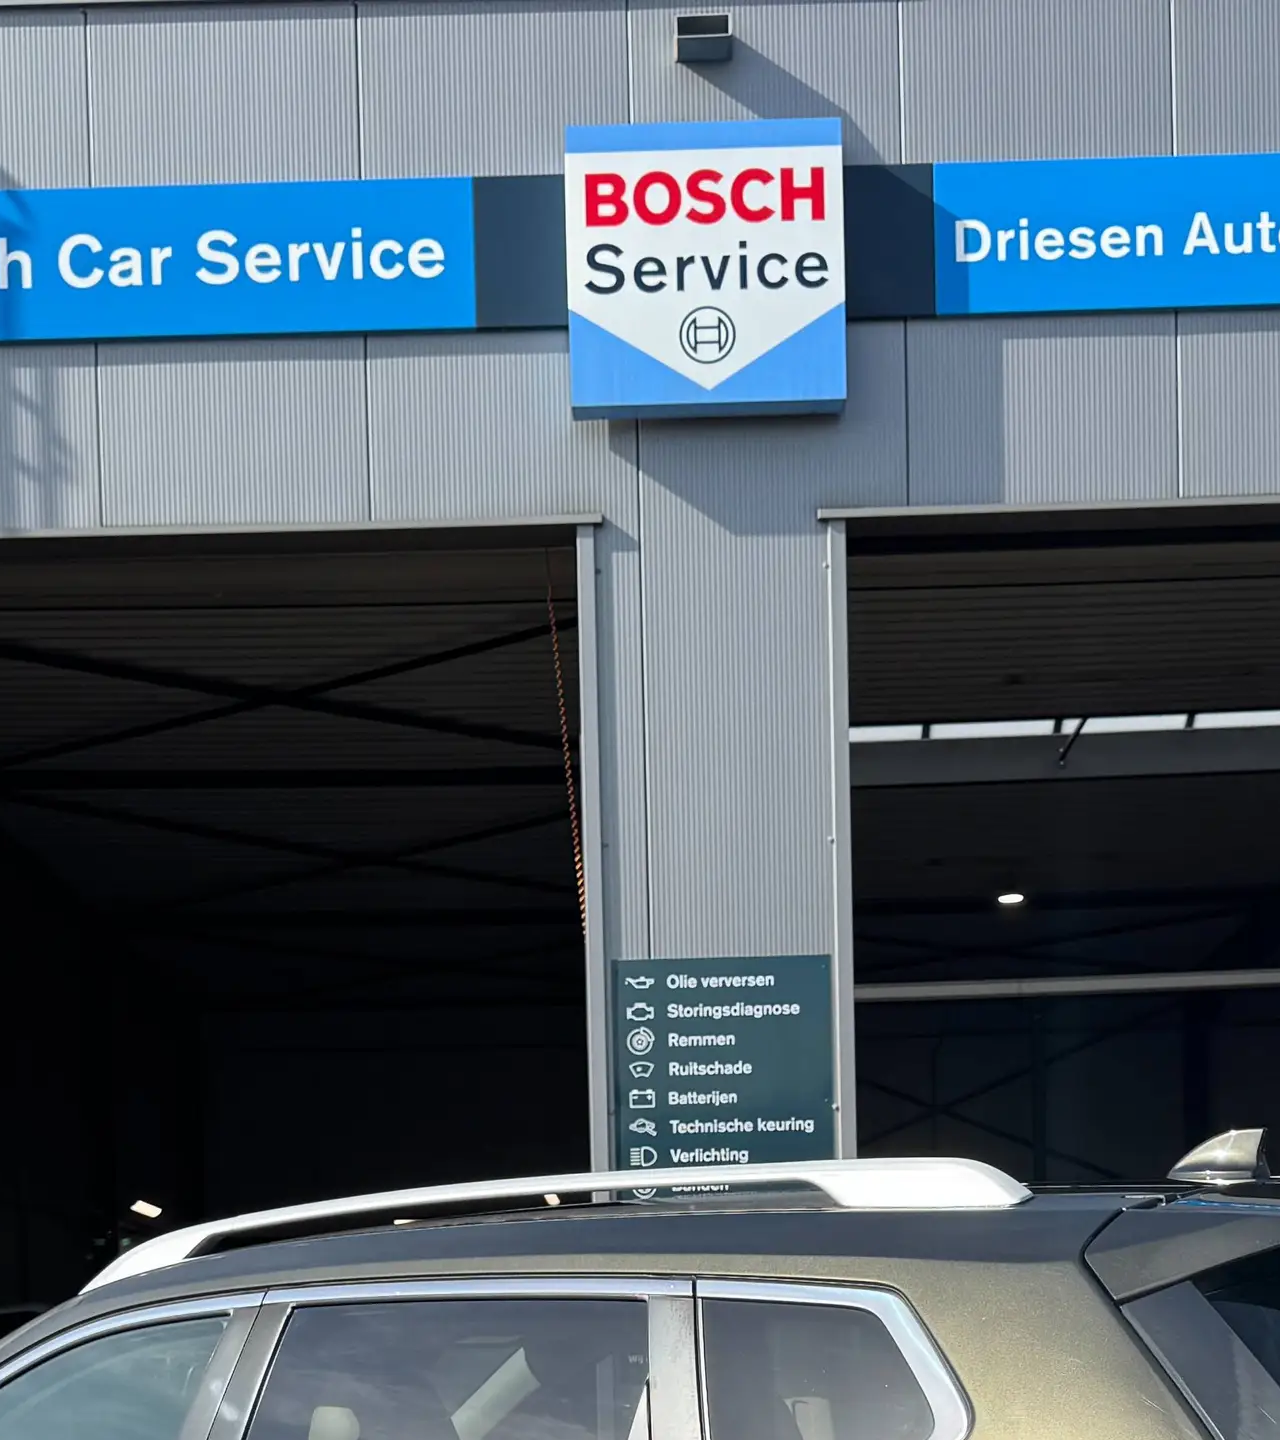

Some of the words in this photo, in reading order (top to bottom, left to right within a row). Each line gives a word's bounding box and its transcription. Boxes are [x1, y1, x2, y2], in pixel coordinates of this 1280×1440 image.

[584, 167, 825, 227] BOSCH
[955, 219, 1165, 263] Driesen
[58, 233, 174, 289] Car
[195, 228, 446, 285] Service
[584, 241, 829, 295] Service
[666, 974, 698, 989] Olie
[700, 974, 775, 989] verversen
[667, 1002, 801, 1020] Storingsdiagnose
[668, 1032, 736, 1048] Remmen
[668, 1060, 753, 1077] Ruitschade
[668, 1090, 738, 1107] Batterijen
[669, 1118, 755, 1135] Technische
[757, 1117, 815, 1134] keuring
[670, 1148, 750, 1165] Verlichting
